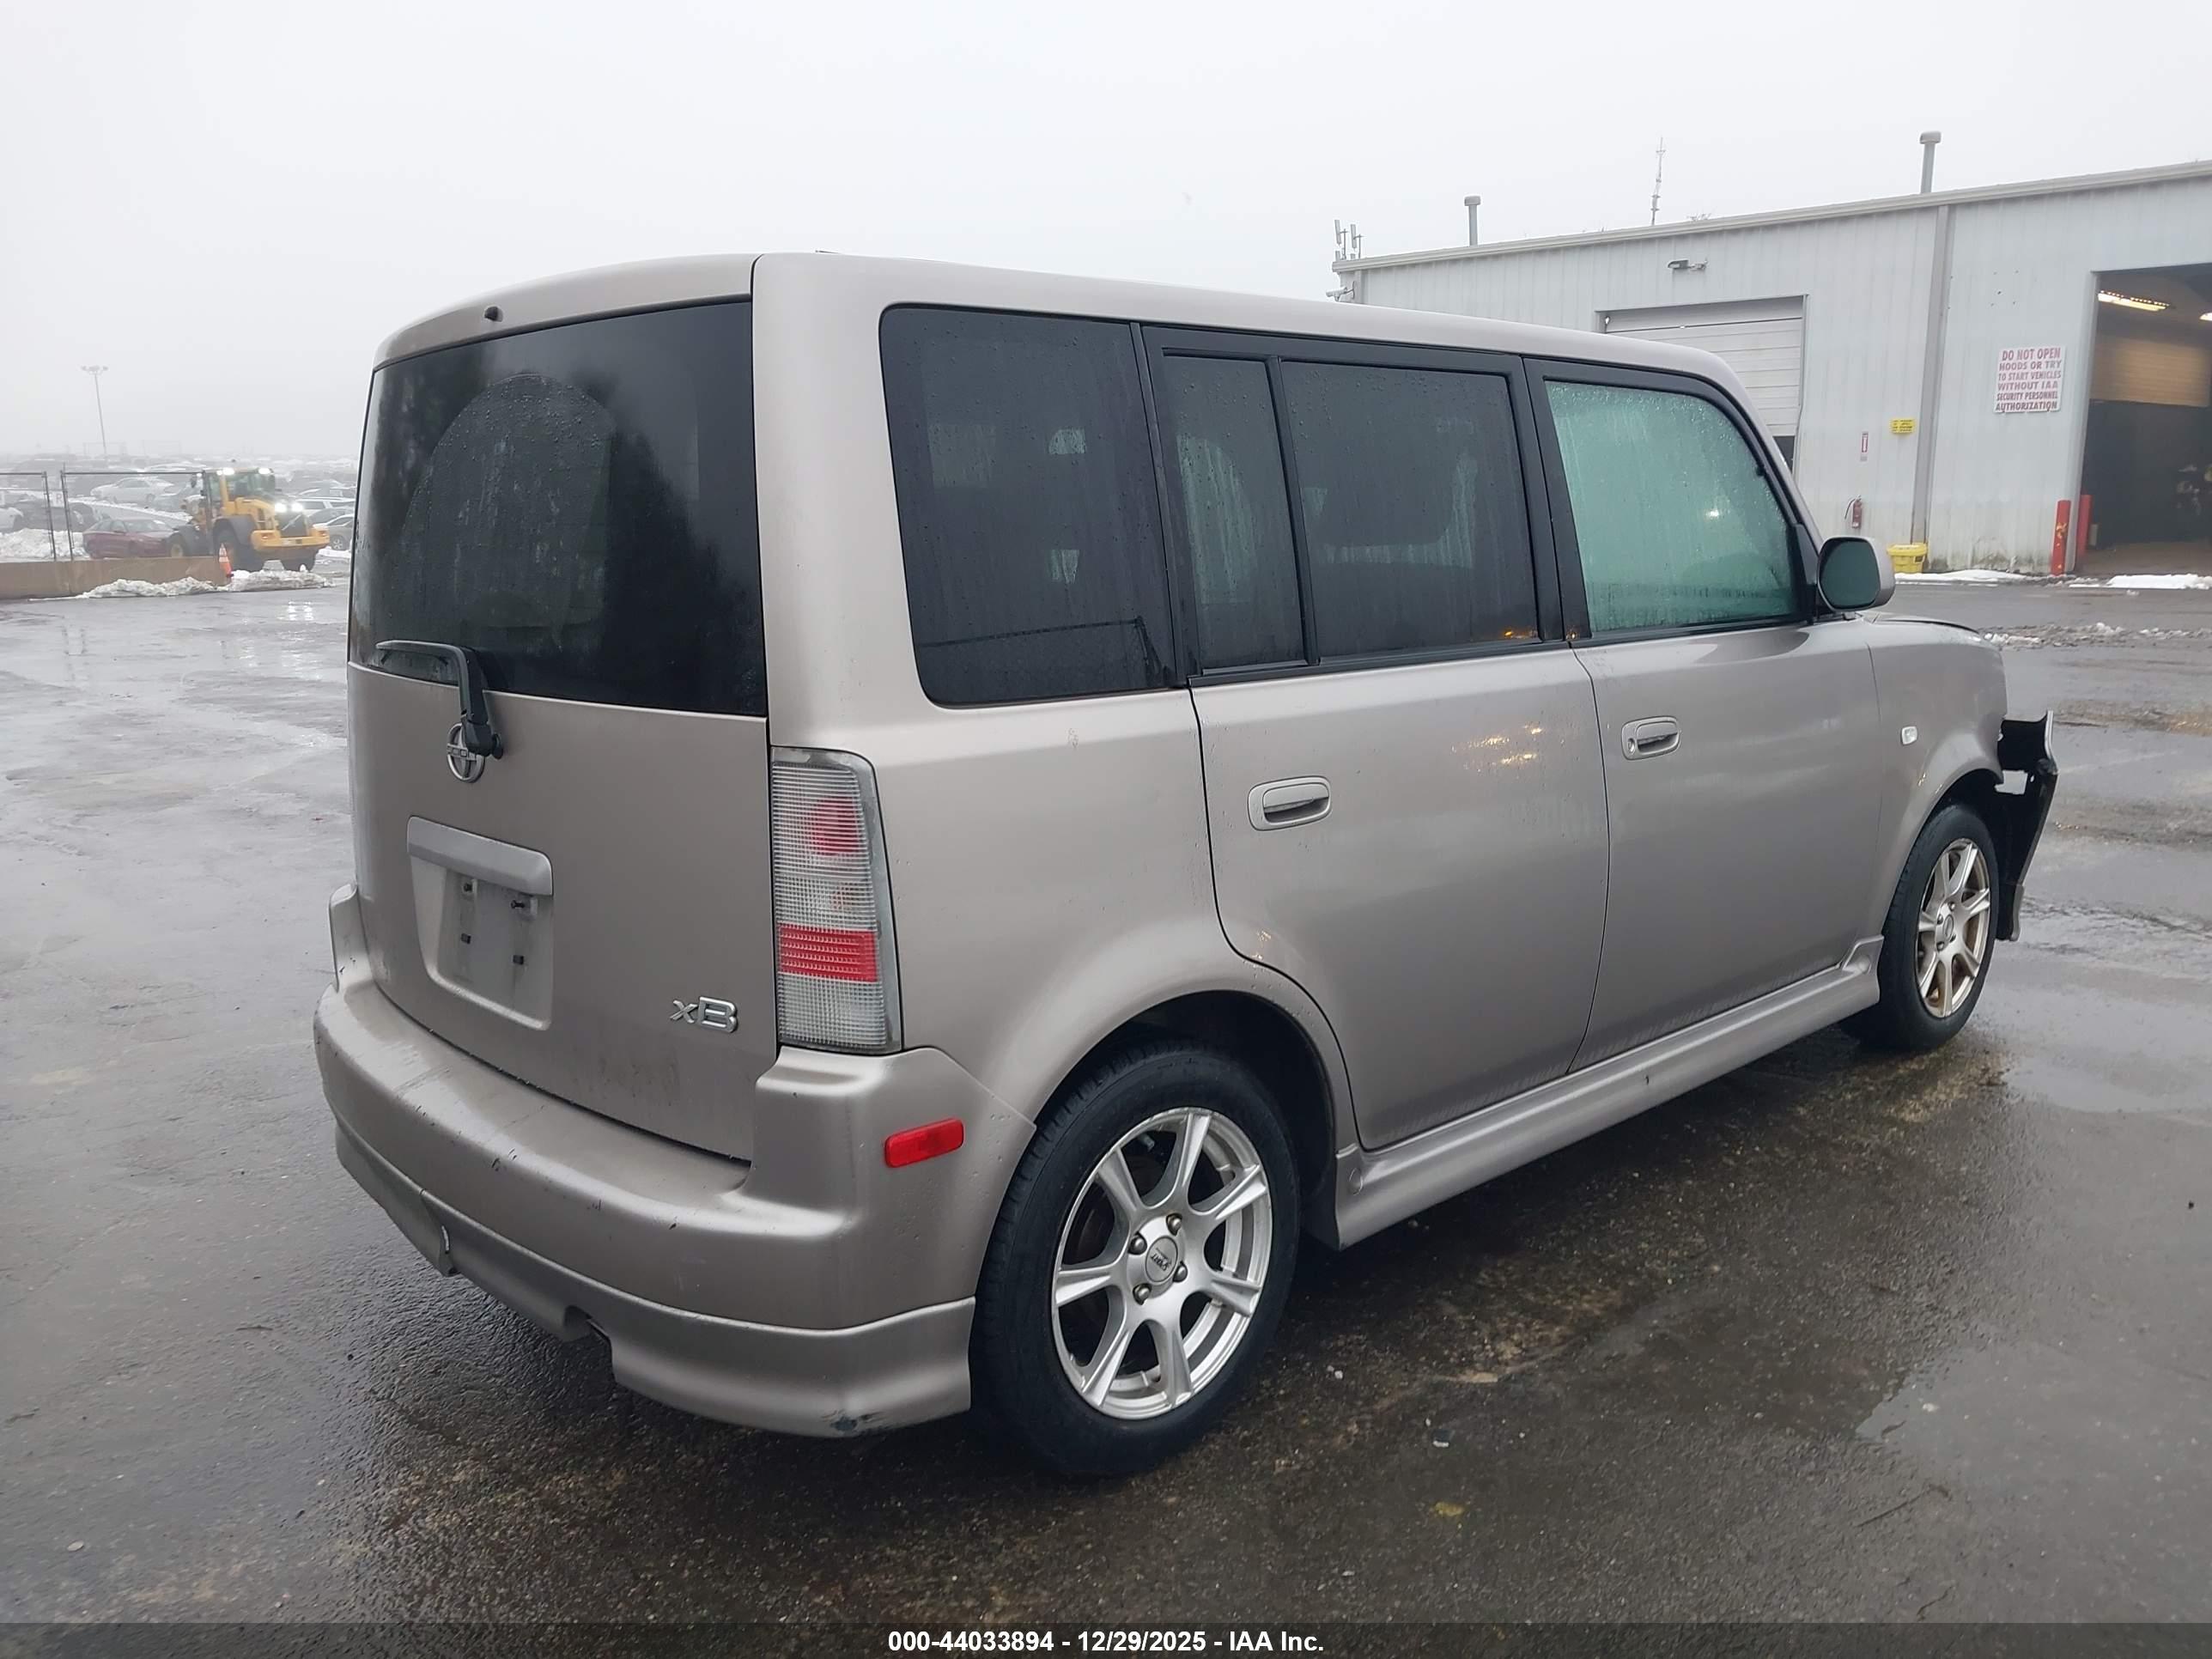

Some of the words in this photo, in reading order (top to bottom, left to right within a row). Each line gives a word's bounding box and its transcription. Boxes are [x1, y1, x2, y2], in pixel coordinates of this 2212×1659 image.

[2002, 350, 2014, 361] DO
[2017, 349, 2034, 360] NOT
[2037, 348, 2060, 359] OPEN
[1999, 362, 2027, 371] HOODS
[2030, 361, 2042, 369] OR
[1998, 373, 2006, 381] TO
[2008, 372, 2028, 380] START
[2031, 370, 2061, 380] VEHICLES
[1998, 382, 2039, 391] WITHOUT
[2041, 380, 2058, 389] IAA
[1996, 392, 2023, 401] SECURITY
[1996, 402, 2057, 410] AUTHORIZATION
[670, 996, 738, 1033] xB
